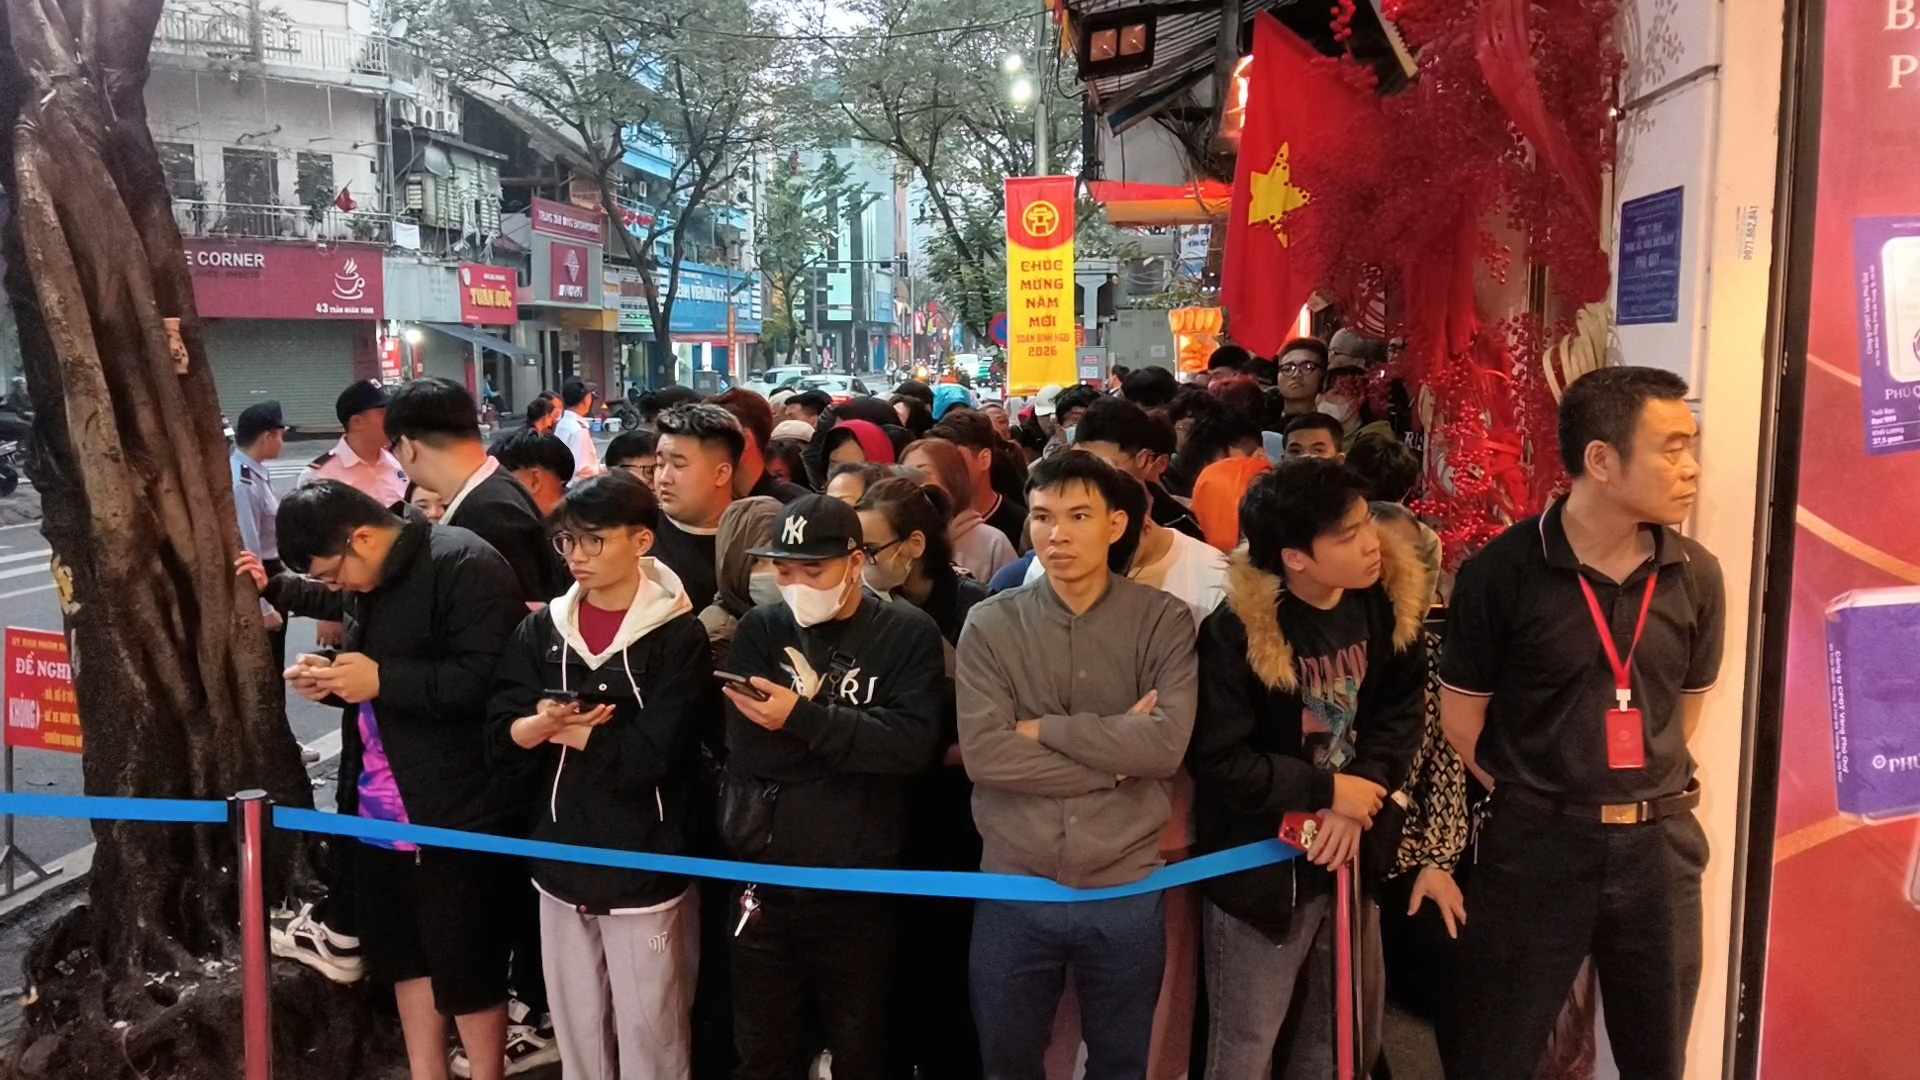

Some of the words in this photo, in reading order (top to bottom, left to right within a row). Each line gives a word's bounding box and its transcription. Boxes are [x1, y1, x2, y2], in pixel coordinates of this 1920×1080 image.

[197, 251, 265, 268] CORNER
[1021, 257, 1063, 272] CHÚC
[1020, 277, 1064, 291] MỪNG
[315, 302, 329, 314] 43
[1029, 314, 1056, 328] MỚI
[1028, 345, 1058, 357] 2026
[16, 651, 35, 676] ĐỀ
[37, 660, 72, 684] NGHỊ
